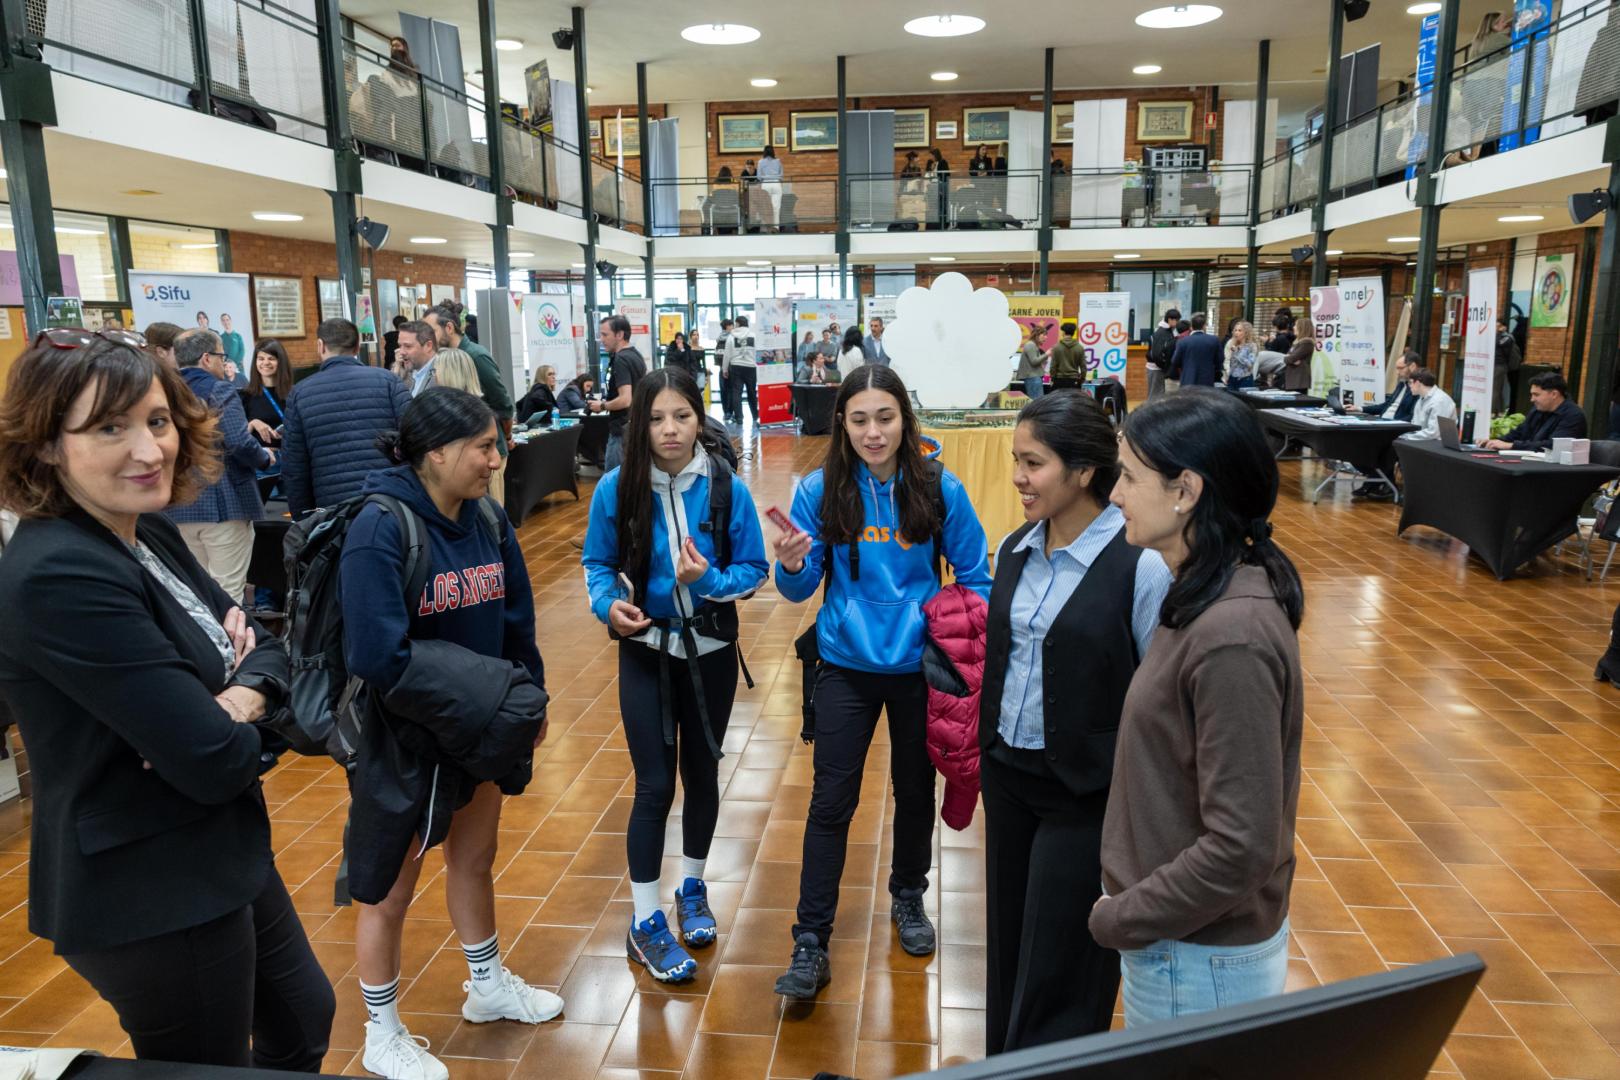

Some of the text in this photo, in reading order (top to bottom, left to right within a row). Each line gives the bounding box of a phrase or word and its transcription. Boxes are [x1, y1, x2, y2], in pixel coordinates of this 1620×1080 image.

[158, 285, 191, 300] Sifu
[1344, 285, 1367, 301] anel
[1035, 308, 1060, 316] JOVEN
[1316, 313, 1340, 321] conso
[1315, 323, 1341, 338] EDE
[530, 338, 573, 346] INCLUYENDO
[418, 571, 460, 616] LOS
